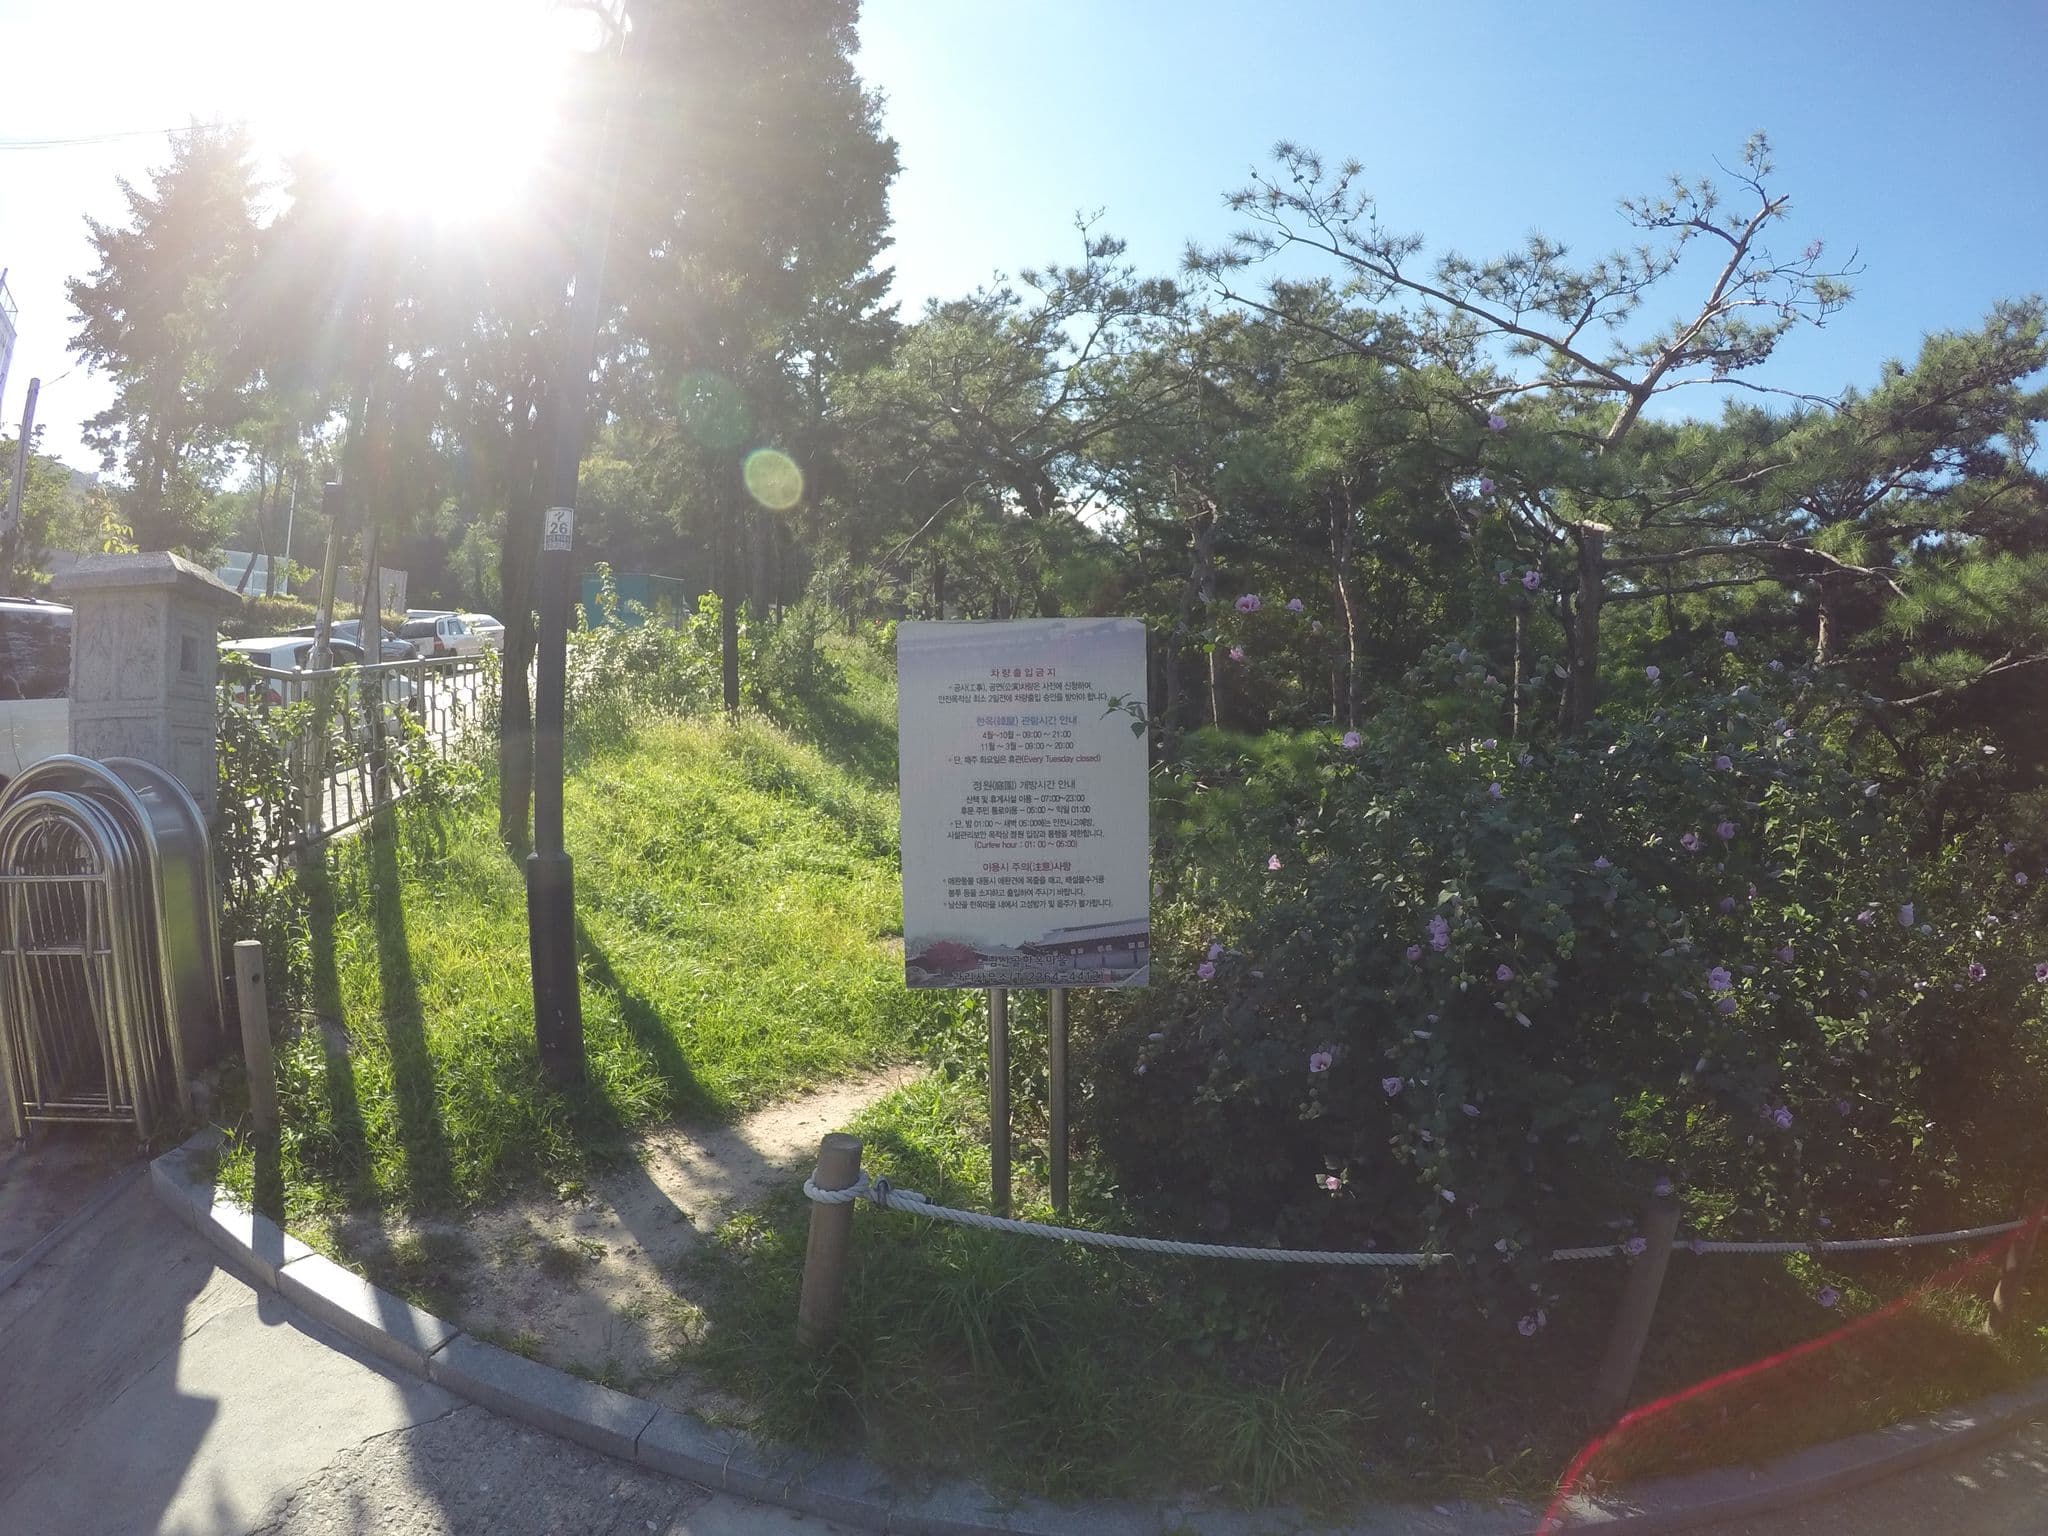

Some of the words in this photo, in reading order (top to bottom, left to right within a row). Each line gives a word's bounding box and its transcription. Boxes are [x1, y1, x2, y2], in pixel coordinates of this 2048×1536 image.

[550, 522, 568, 535] 26
[1059, 714, 1078, 725] 안내
[1052, 730, 1072, 739] 21:00
[1054, 741, 1074, 750] 20:00
[1045, 755, 1074, 764] Tuesday
[1019, 779, 1055, 790] 개방시간
[1057, 779, 1076, 789] 안내
[1070, 804, 1091, 813] 01:00
[973, 819, 994, 828] 01:00
[1001, 840, 1018, 849] hour
[982, 862, 1009, 873] 이용시
